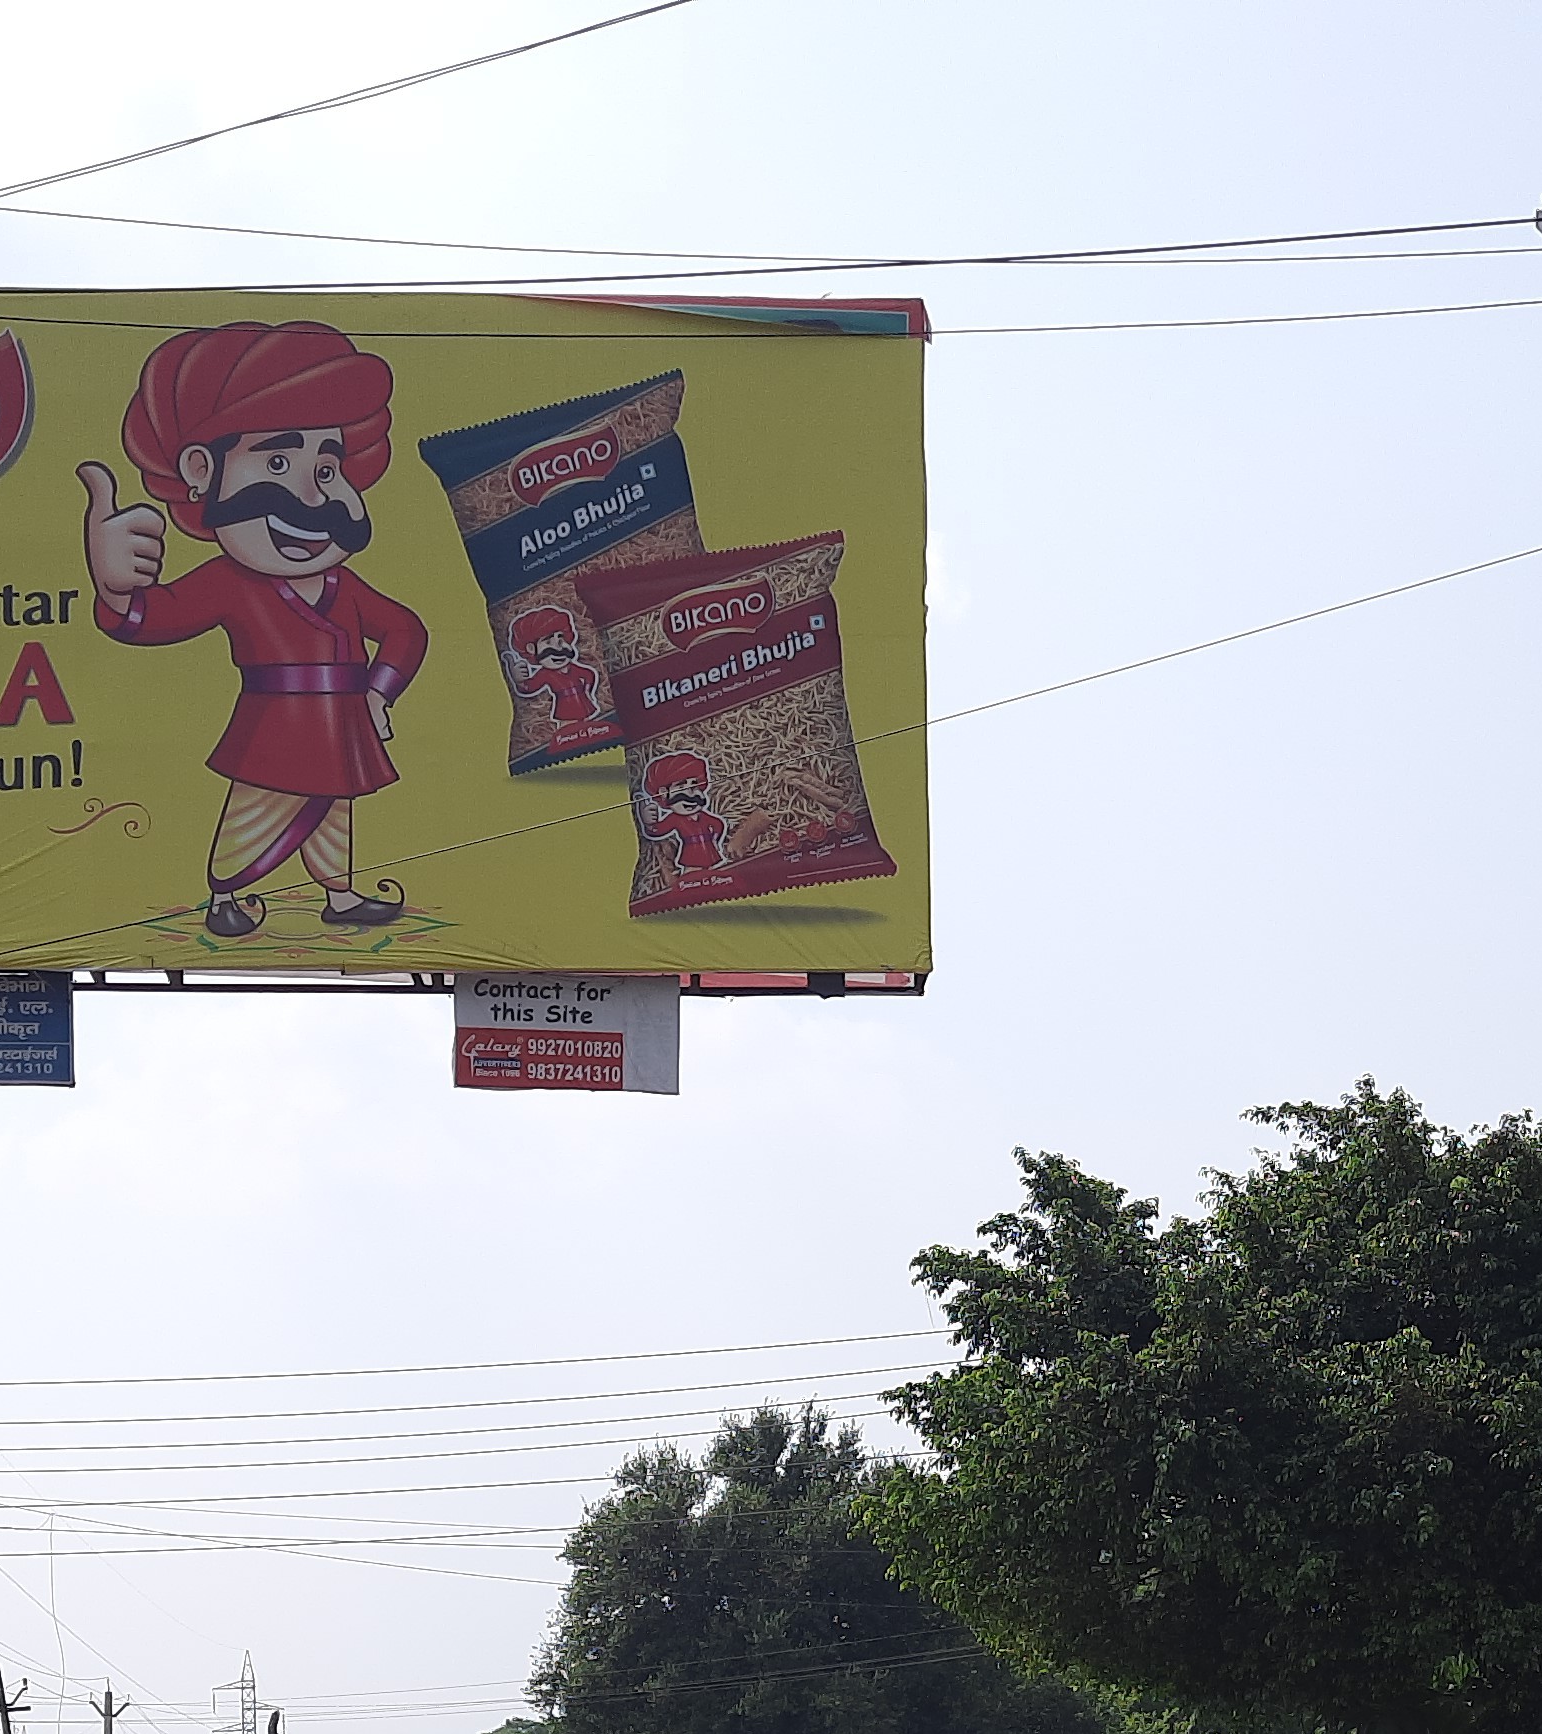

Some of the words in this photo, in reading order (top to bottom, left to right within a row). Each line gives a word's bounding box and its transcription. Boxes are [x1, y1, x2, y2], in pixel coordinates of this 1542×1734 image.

[520, 521, 571, 559] Aloo
[573, 483, 645, 530] Bhujia
[642, 654, 738, 709] Bikaneri
[742, 631, 816, 671] Bhujia
[473, 978, 563, 1000] Contact
[573, 982, 611, 1002] for
[490, 1002, 534, 1022] this
[545, 1005, 593, 1024] Site
[462, 1034, 521, 1058] Galaxy
[527, 1038, 622, 1058] 9927010820
[527, 1063, 621, 1083] 9837241310
